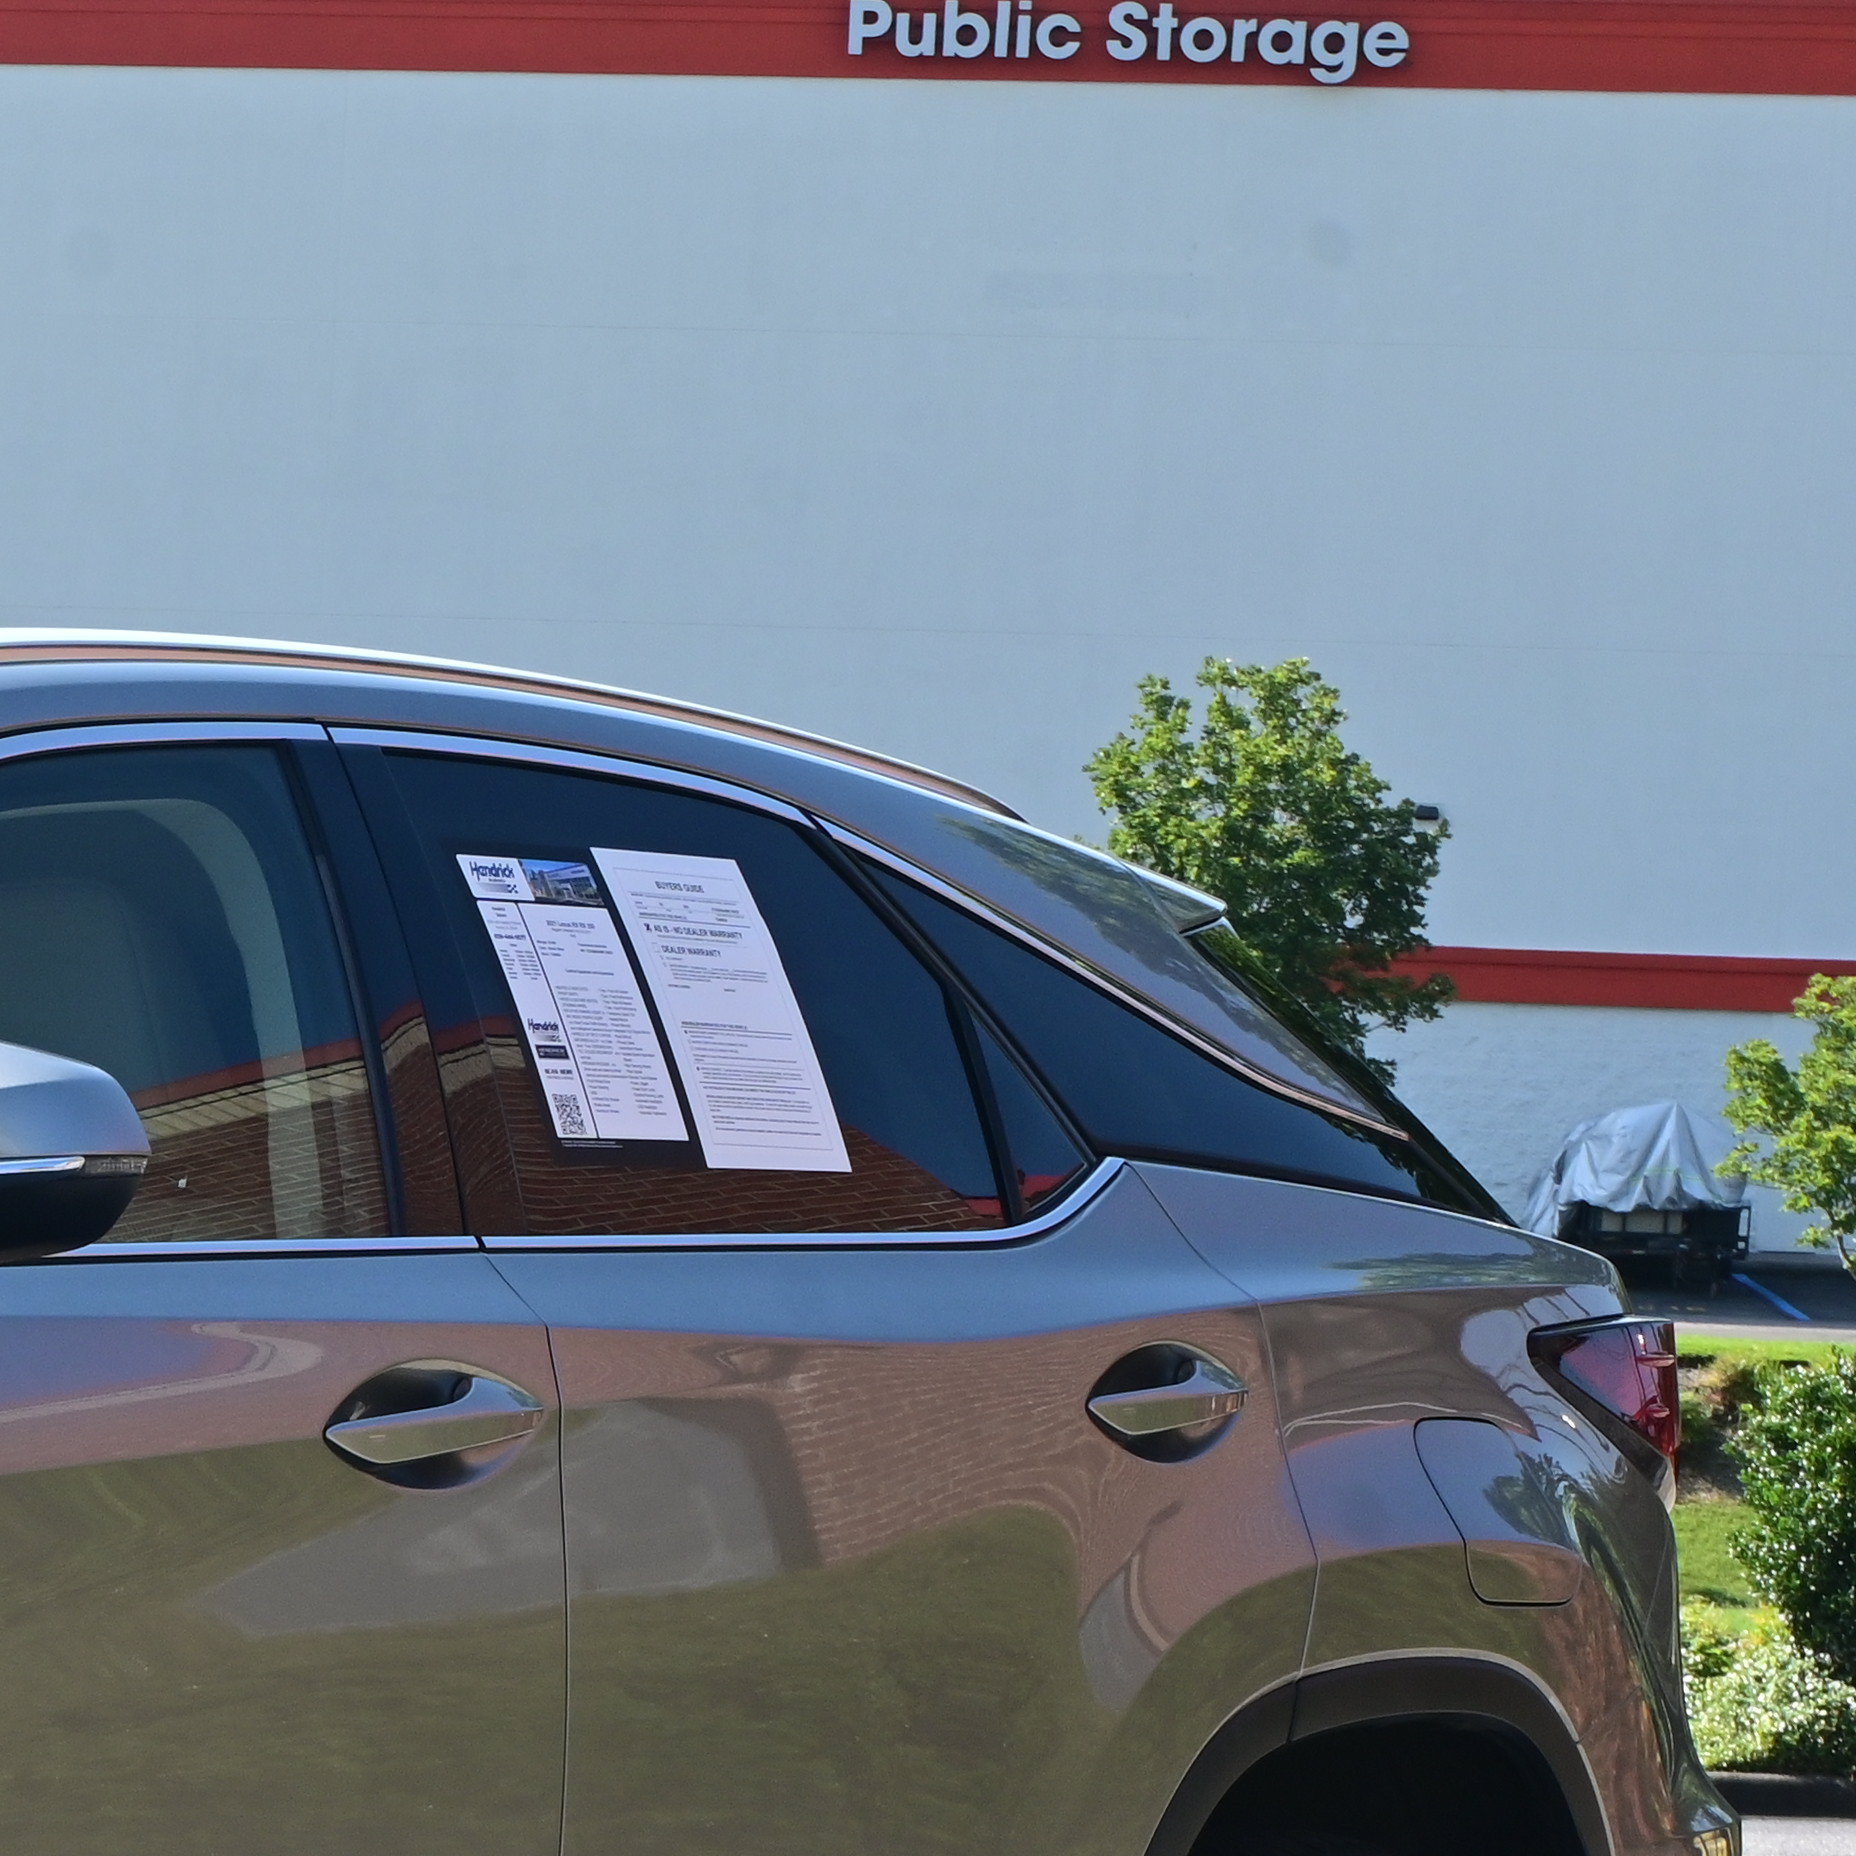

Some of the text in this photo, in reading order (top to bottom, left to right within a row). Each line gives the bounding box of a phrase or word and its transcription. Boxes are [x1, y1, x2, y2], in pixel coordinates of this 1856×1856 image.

[847, 0, 1410, 84] Public Storage
[469, 861, 515, 882] Hendrick
[683, 927, 708, 937] DEALER
[709, 929, 743, 940] WARRANTY
[661, 945, 721, 958] DEALER WARRANTY
